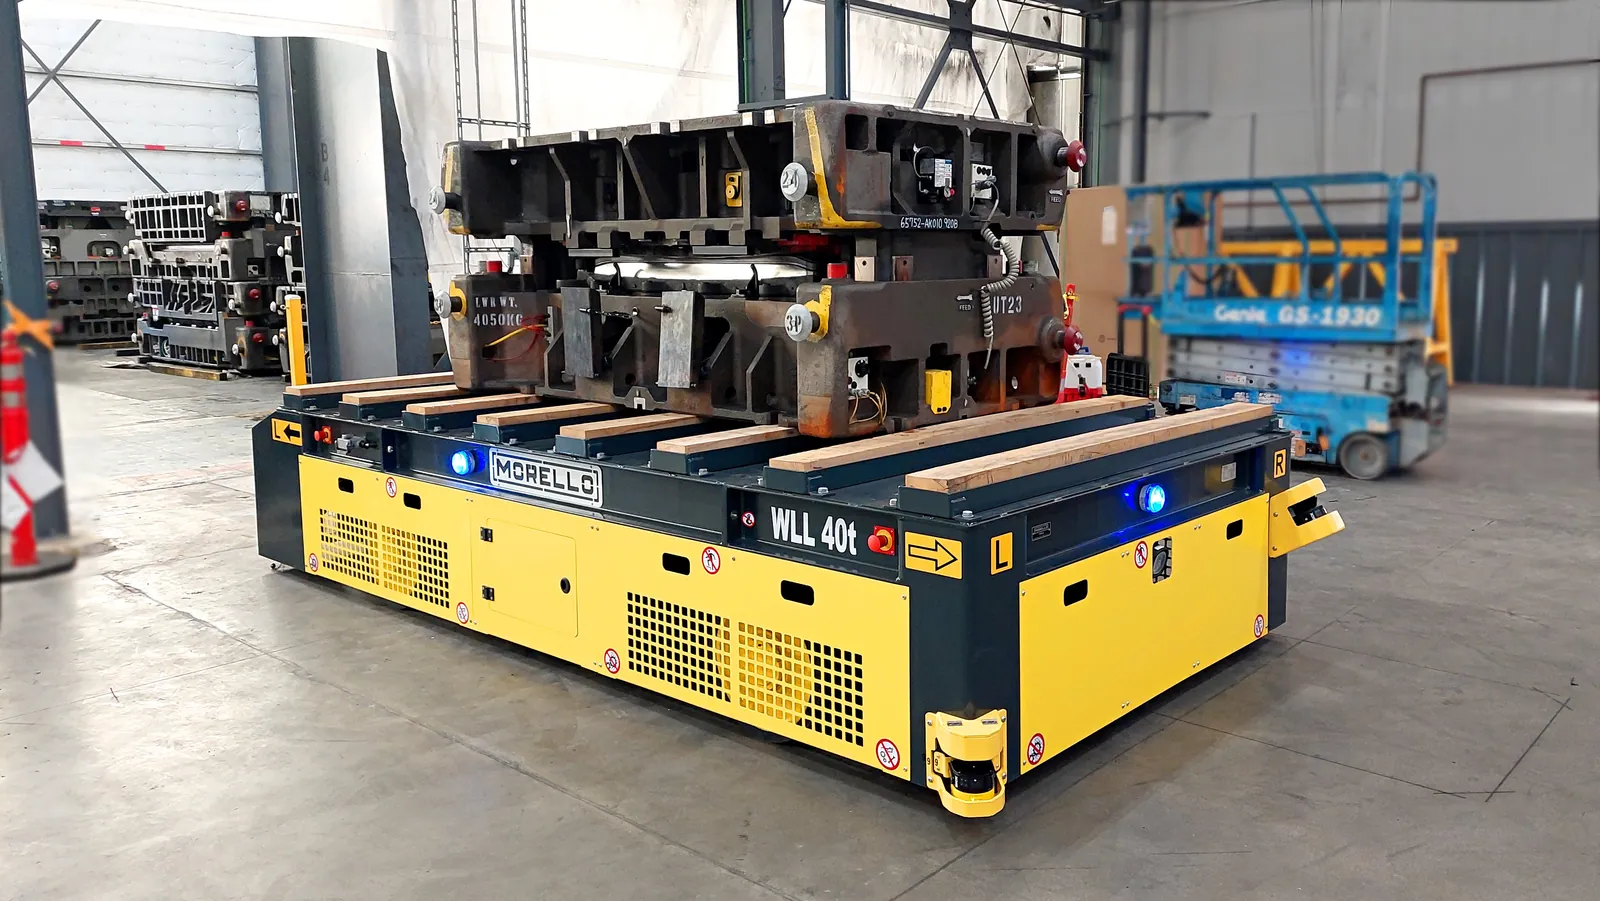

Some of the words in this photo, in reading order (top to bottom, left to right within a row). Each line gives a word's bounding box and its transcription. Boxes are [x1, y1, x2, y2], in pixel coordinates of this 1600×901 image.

[475, 297, 496, 308] LWR
[1278, 305, 1382, 326] GS-1930
[496, 458, 594, 495] MORELLO
[1275, 453, 1284, 476] R
[771, 506, 816, 547] WLL
[821, 515, 857, 556] 40t
[995, 539, 1009, 571] L
